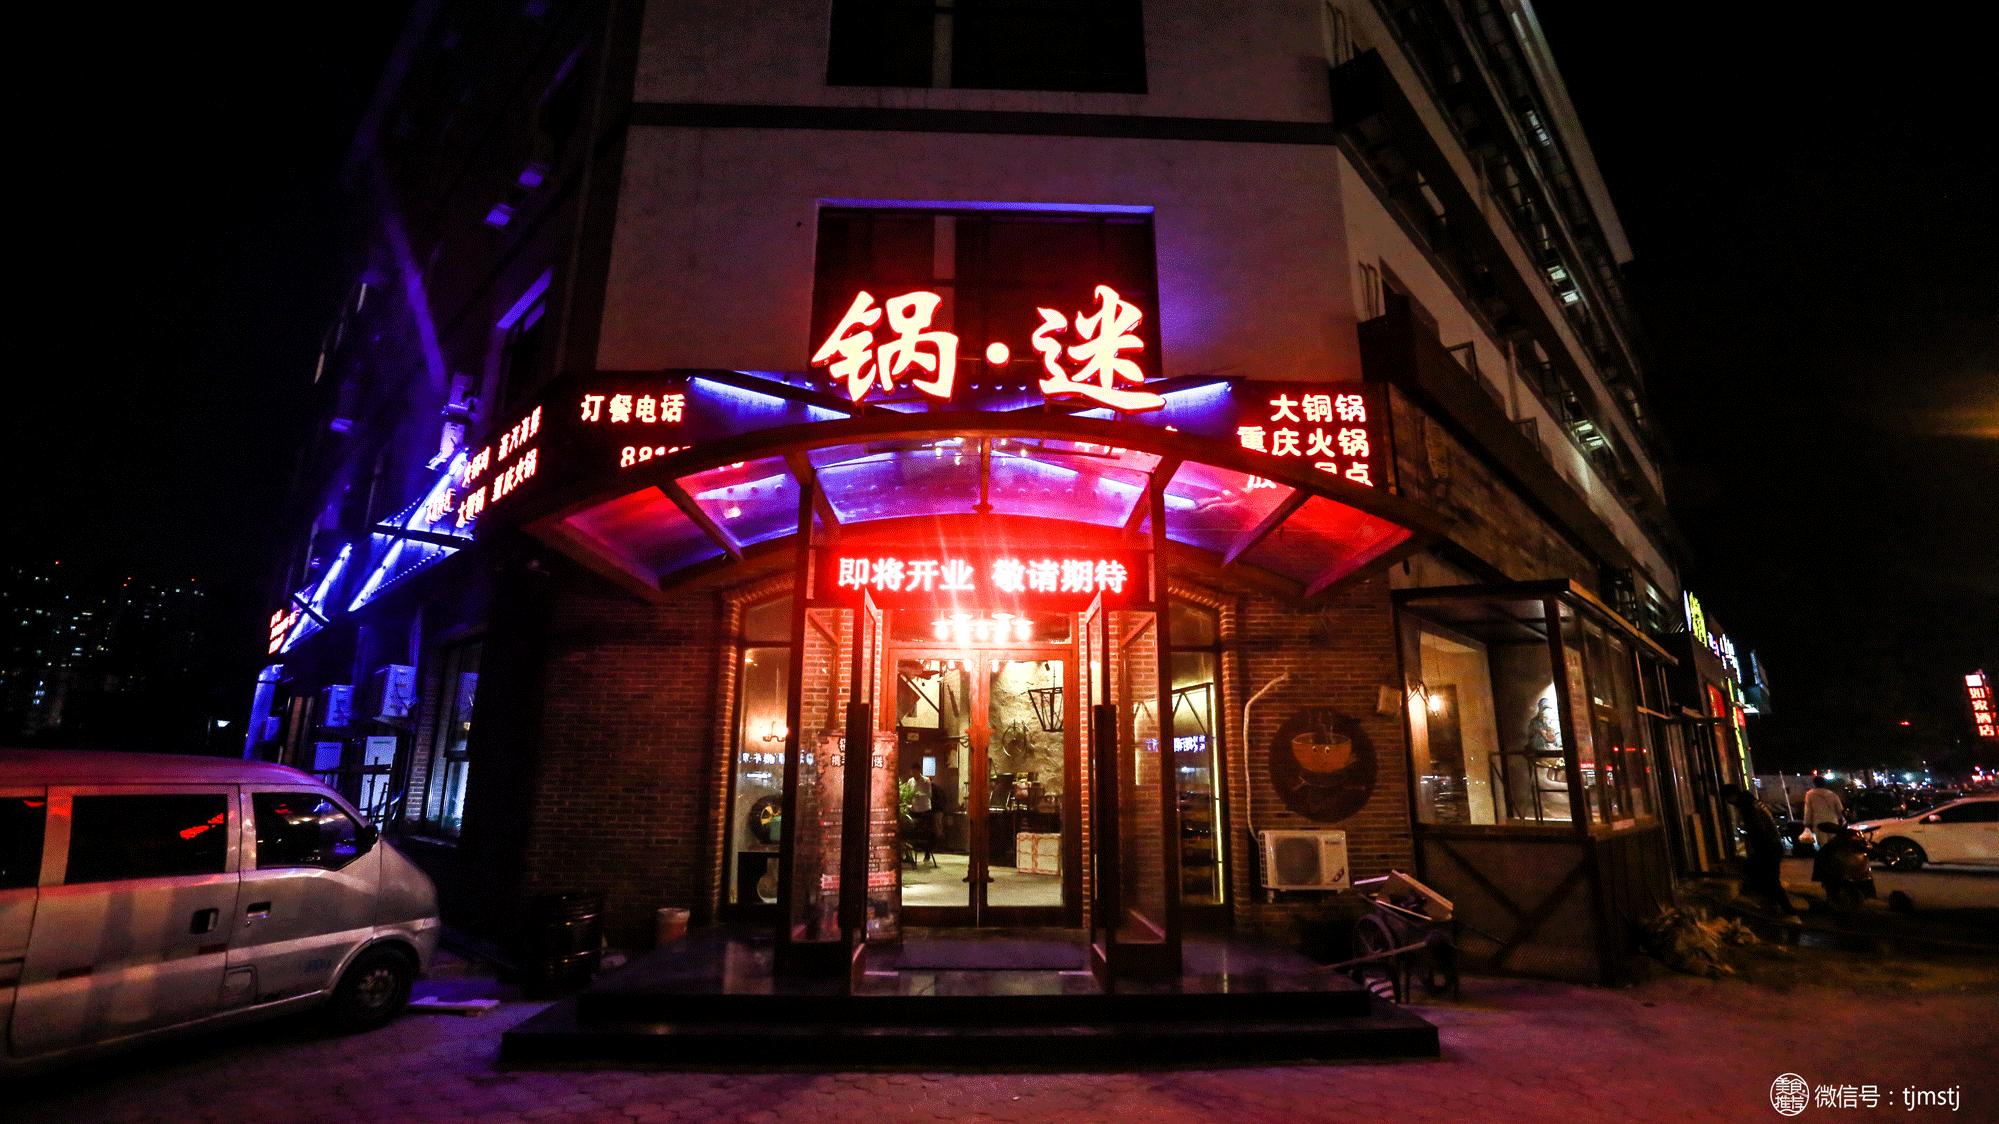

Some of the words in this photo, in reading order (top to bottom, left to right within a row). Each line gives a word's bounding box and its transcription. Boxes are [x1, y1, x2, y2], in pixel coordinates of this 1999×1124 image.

[580, 394, 685, 423] 订餐电话
[1269, 394, 1367, 422] 大铜锅
[1237, 426, 1370, 458] 重庆火锅
[838, 557, 976, 591] 即将开业
[991, 558, 1128, 593] 敬请期待
